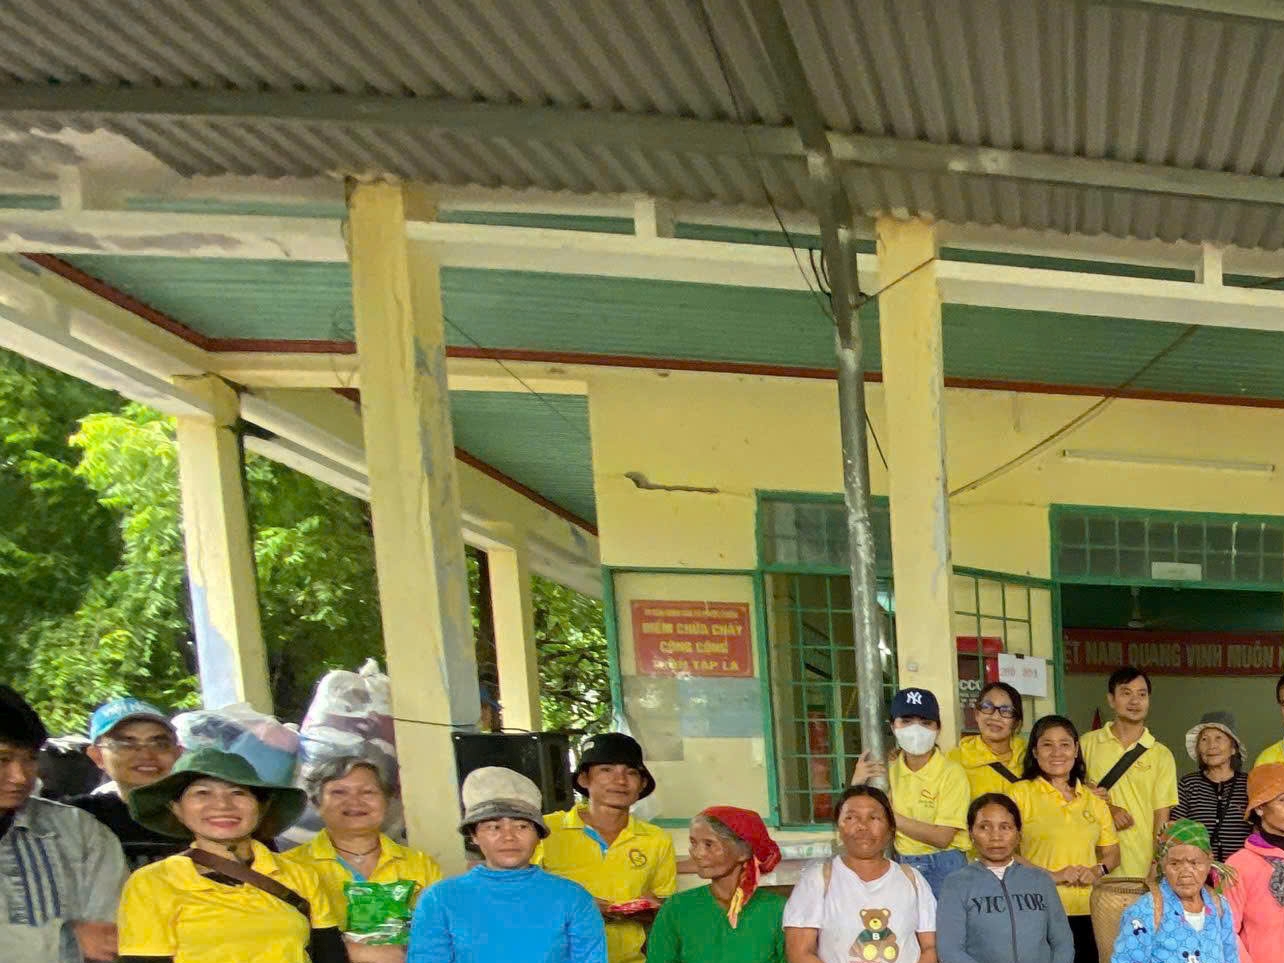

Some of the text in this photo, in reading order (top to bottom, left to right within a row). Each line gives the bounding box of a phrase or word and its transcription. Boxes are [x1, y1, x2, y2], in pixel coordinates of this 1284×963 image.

[1085, 641, 1123, 665] NAM
[1185, 643, 1222, 668] VINH
[906, 691, 923, 705] NY
[970, 893, 1048, 914] VICTOR
[872, 932, 880, 941] B
